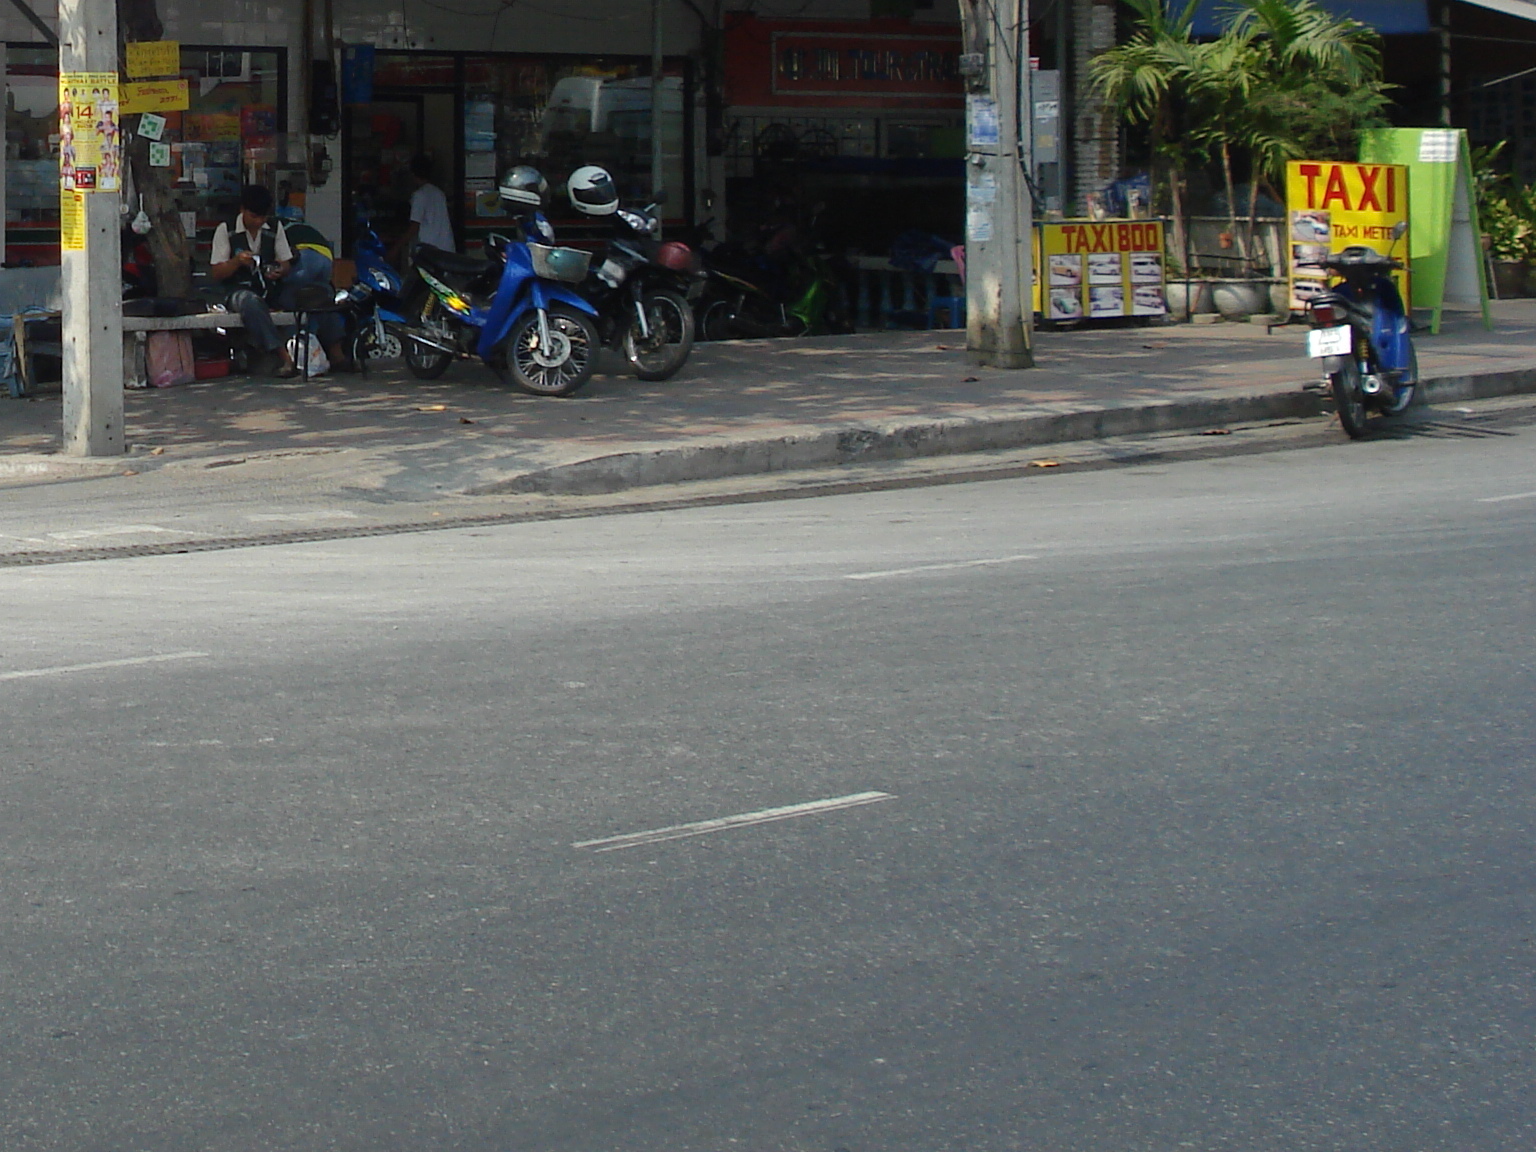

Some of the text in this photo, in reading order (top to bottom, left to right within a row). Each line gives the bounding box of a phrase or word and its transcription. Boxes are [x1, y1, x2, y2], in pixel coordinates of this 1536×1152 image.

[76, 105, 93, 119] 14
[1300, 165, 1396, 213] TAXI
[1061, 223, 1159, 253] TAXI 800
[1332, 224, 1396, 239] TAXI METE
